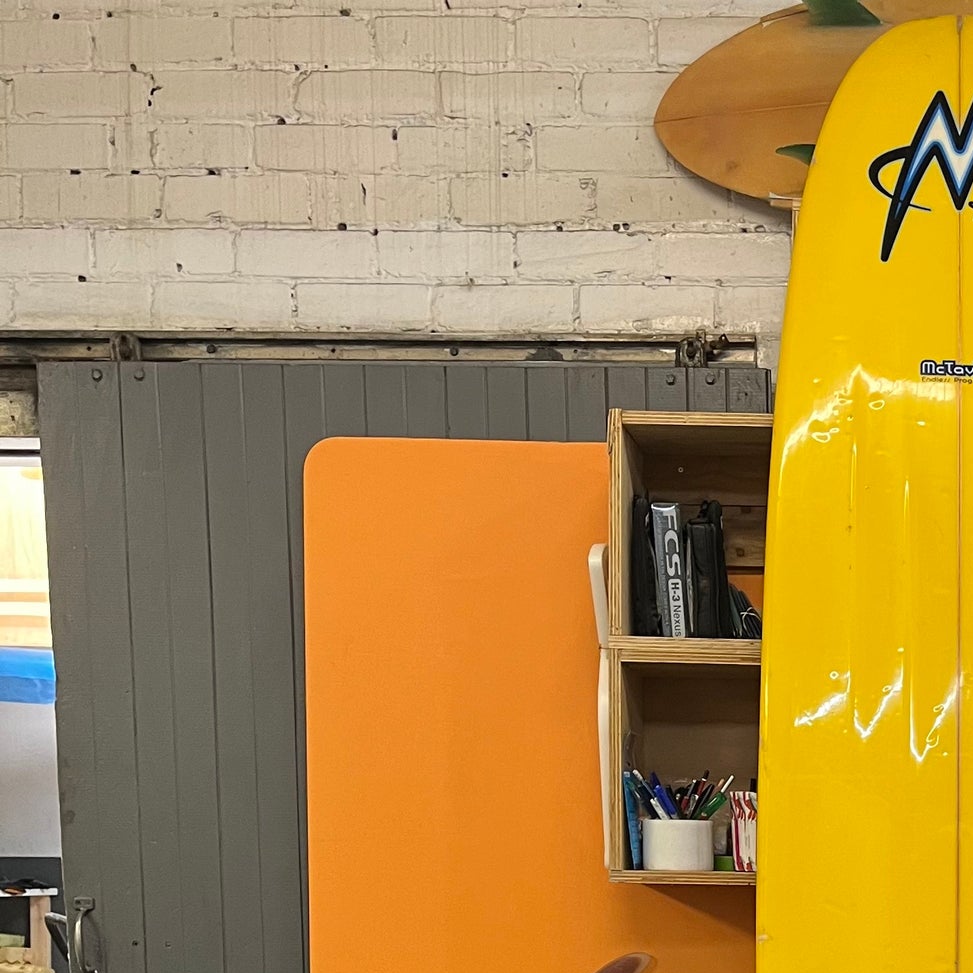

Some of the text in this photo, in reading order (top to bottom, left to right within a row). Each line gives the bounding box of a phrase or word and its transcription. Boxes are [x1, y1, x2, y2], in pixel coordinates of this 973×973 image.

[662, 512, 682, 637] FCS H-3 Nexus
